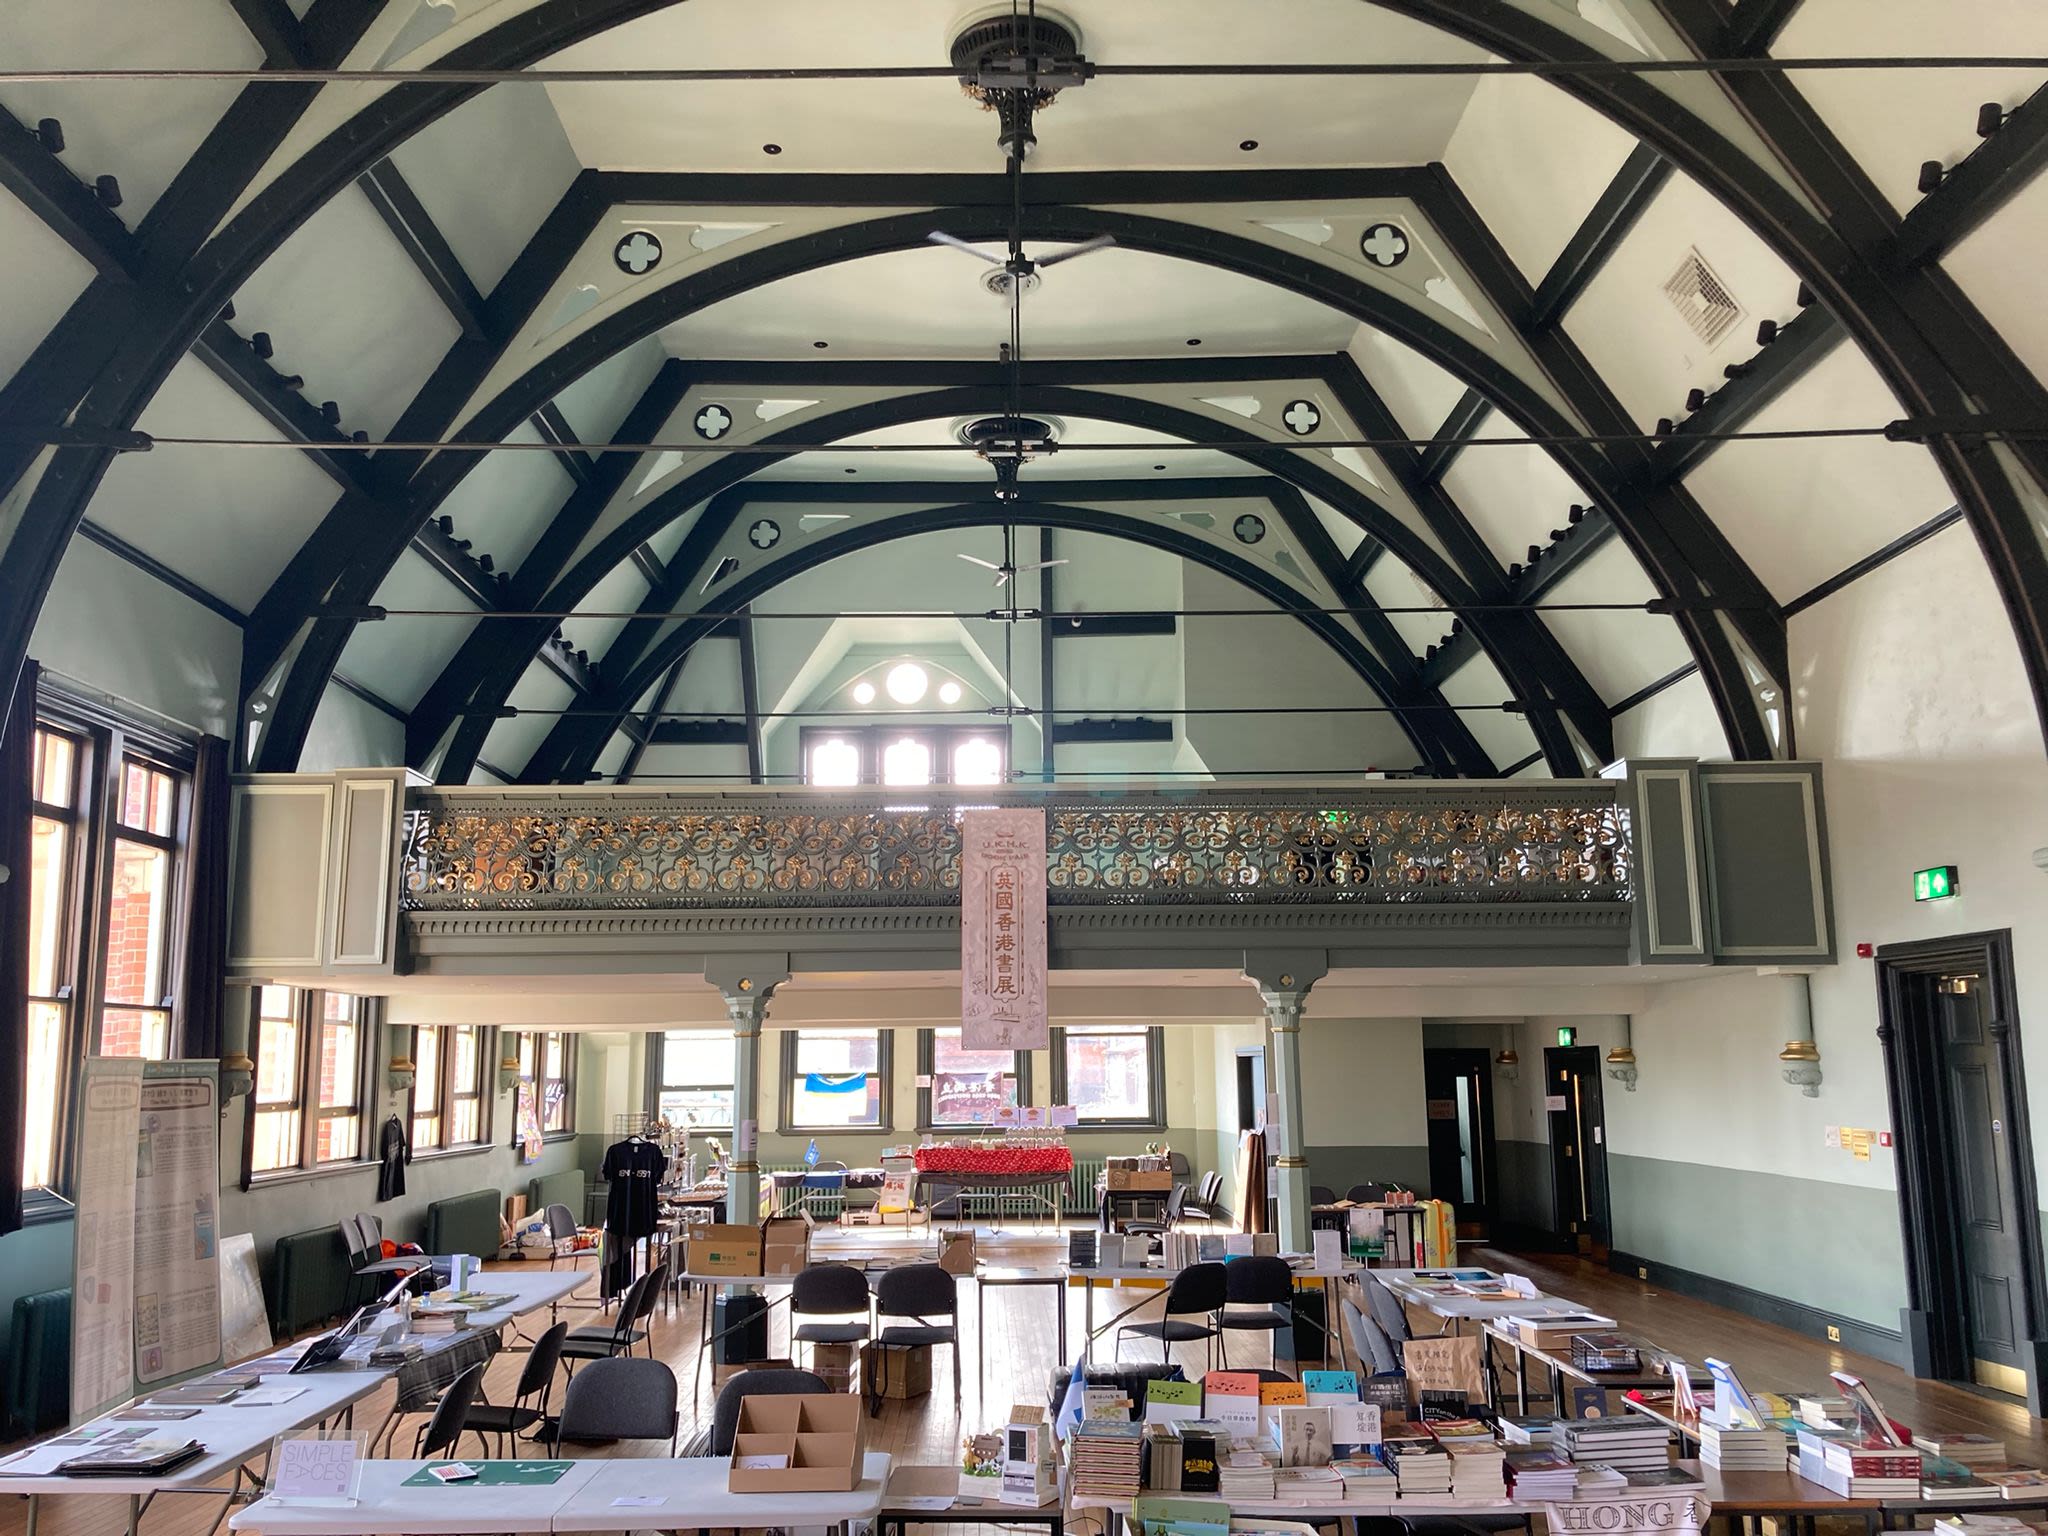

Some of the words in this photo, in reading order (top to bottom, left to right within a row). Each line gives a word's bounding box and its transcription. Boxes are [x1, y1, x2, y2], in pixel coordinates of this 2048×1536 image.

[994, 872, 1016, 994] 英國香港書展
[284, 1444, 354, 1463] SIMPLE
[1558, 1502, 1675, 1530] HONG
